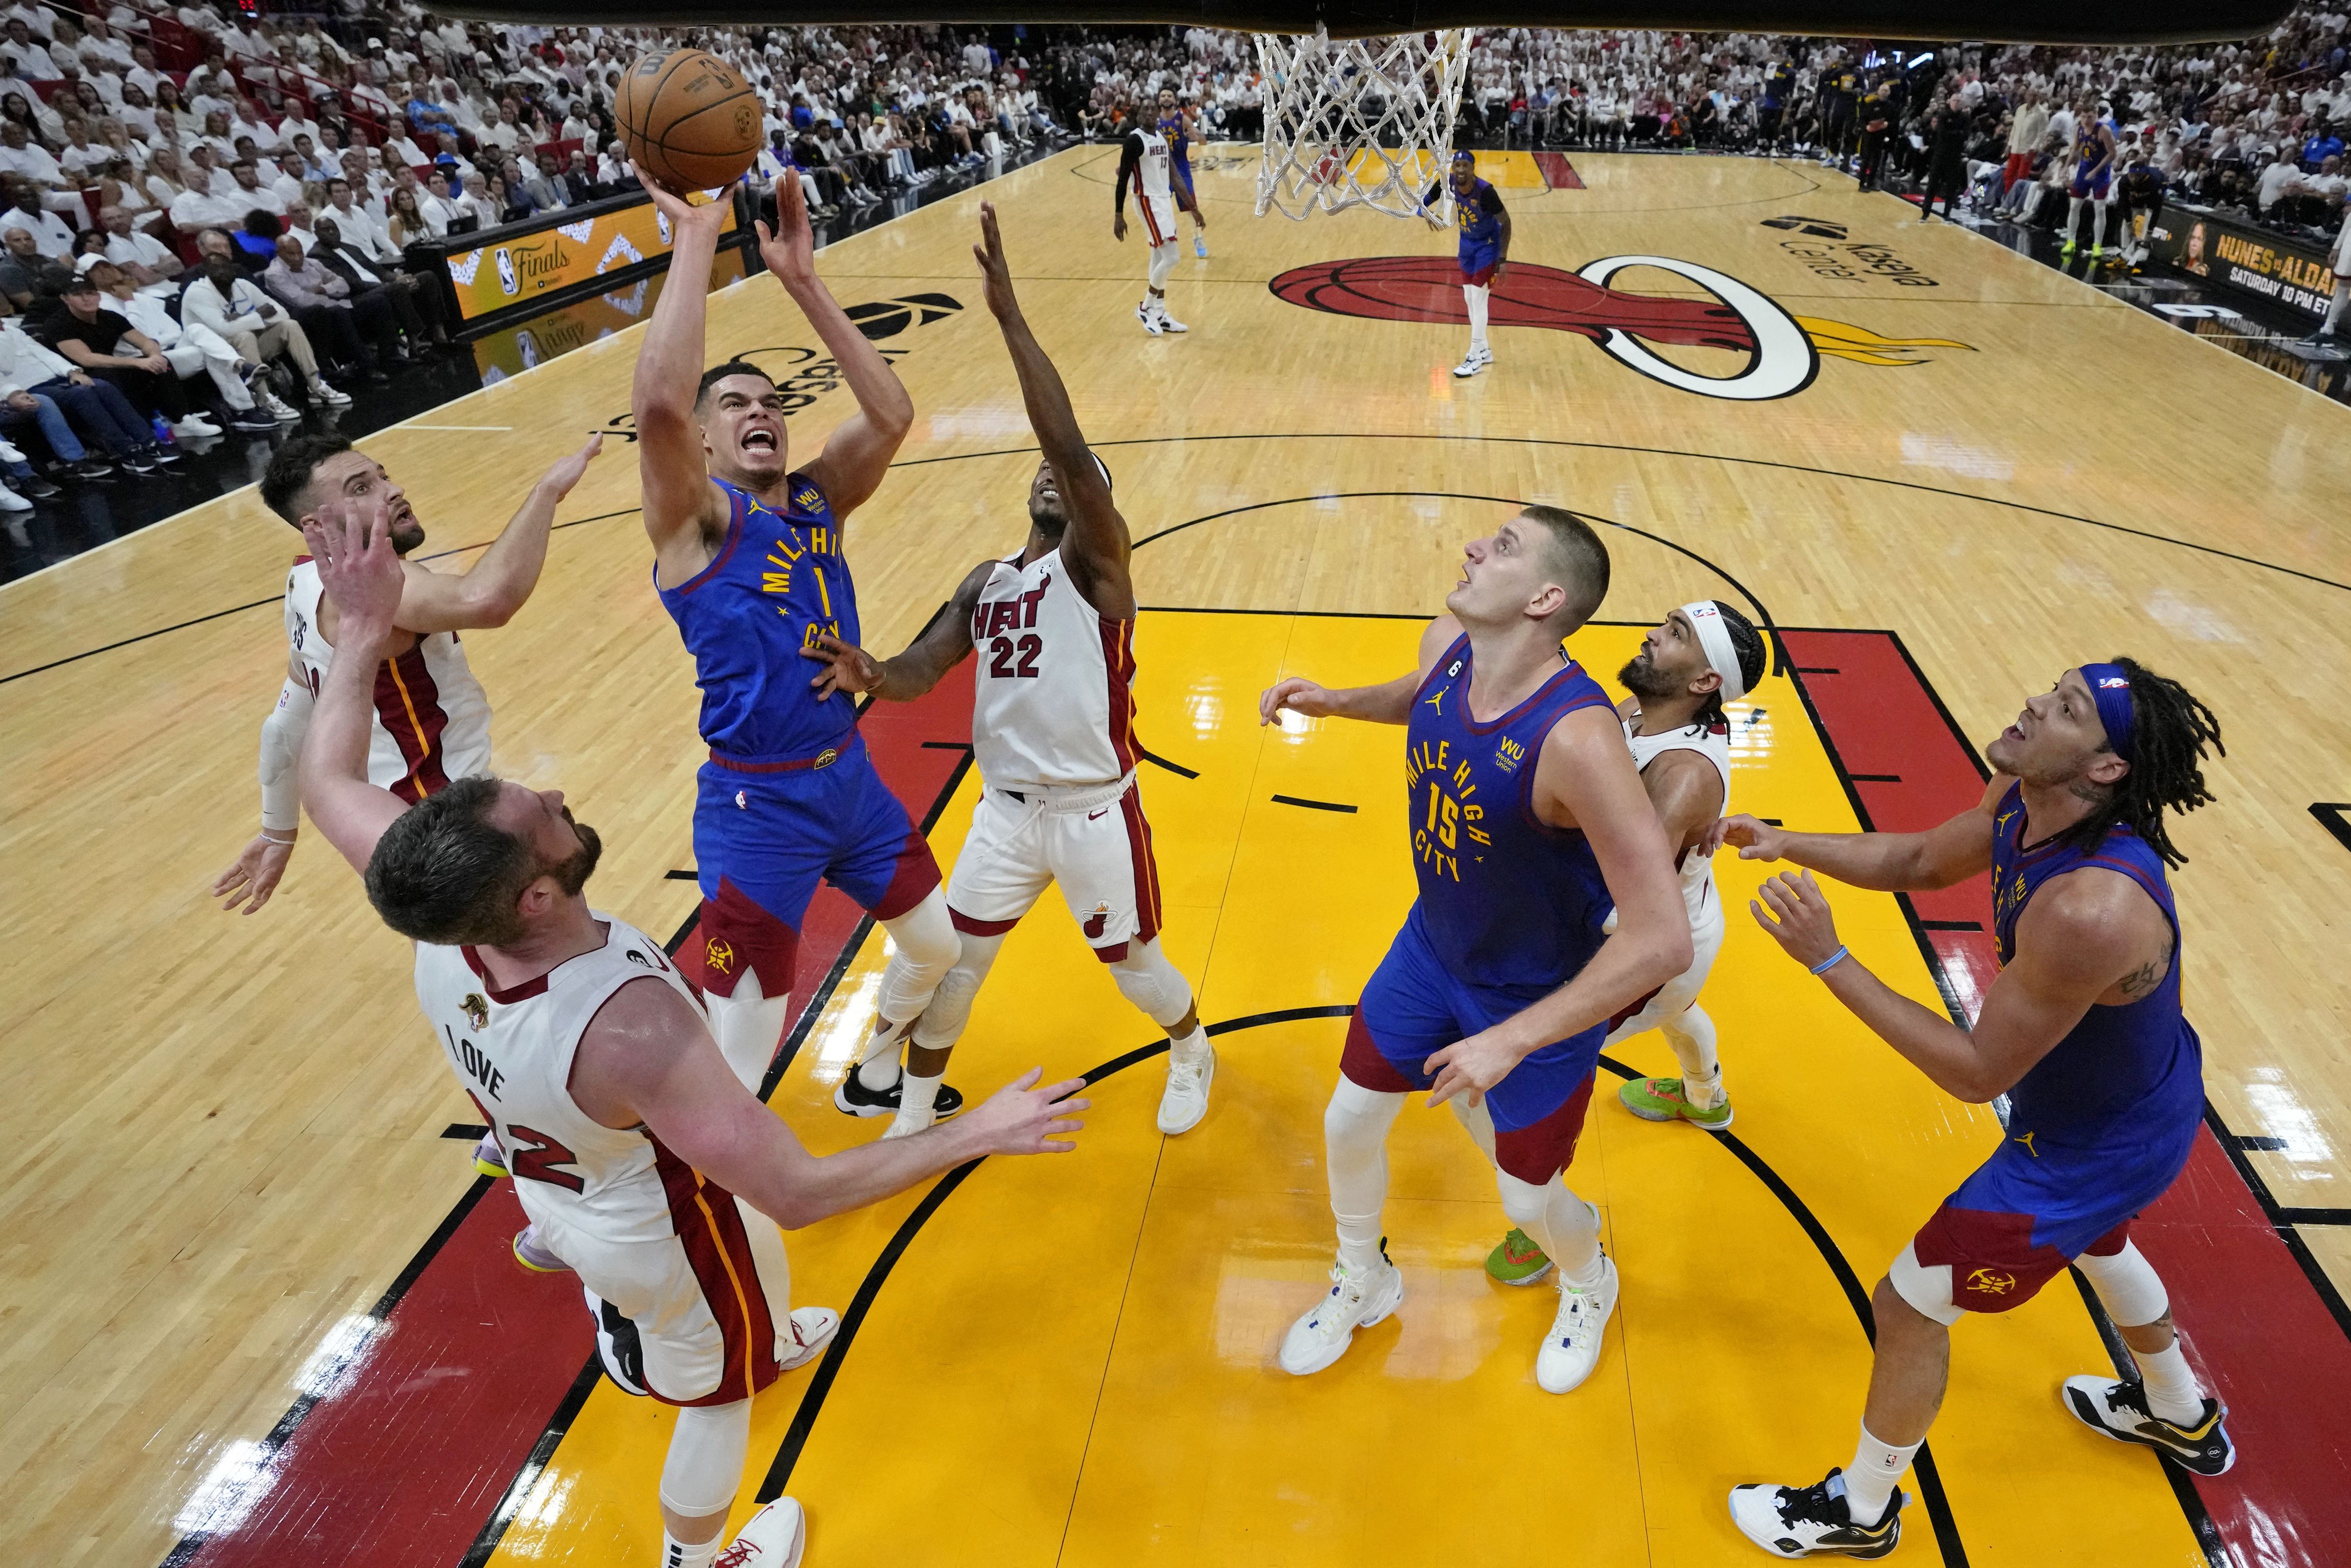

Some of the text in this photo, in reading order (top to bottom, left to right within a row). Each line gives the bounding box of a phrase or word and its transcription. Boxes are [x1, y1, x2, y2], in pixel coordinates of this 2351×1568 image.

[511, 239, 570, 297] Finals
[1779, 241, 1868, 283] Center
[1838, 243, 1940, 287] Kaseya
[2216, 234, 2275, 274] NUNES
[2229, 266, 2332, 315] SATURDAY 10 PM ET
[795, 487, 819, 506] WU
[806, 499, 825, 512] Western
[813, 505, 826, 514] Union
[813, 567, 832, 618] 1
[974, 573, 1052, 640] HEAT
[990, 634, 1043, 678] 22
[1448, 660, 1463, 677] 6
[1495, 750, 1518, 769] Western
[1495, 759, 1512, 774] Union
[1500, 735, 1525, 761] WU
[1406, 740, 1492, 847] MILE HIGH
[1426, 781, 1460, 851] 15
[1415, 828, 1461, 882] CITY
[2015, 872, 2028, 901] WU
[465, 1088, 585, 1196] 2
